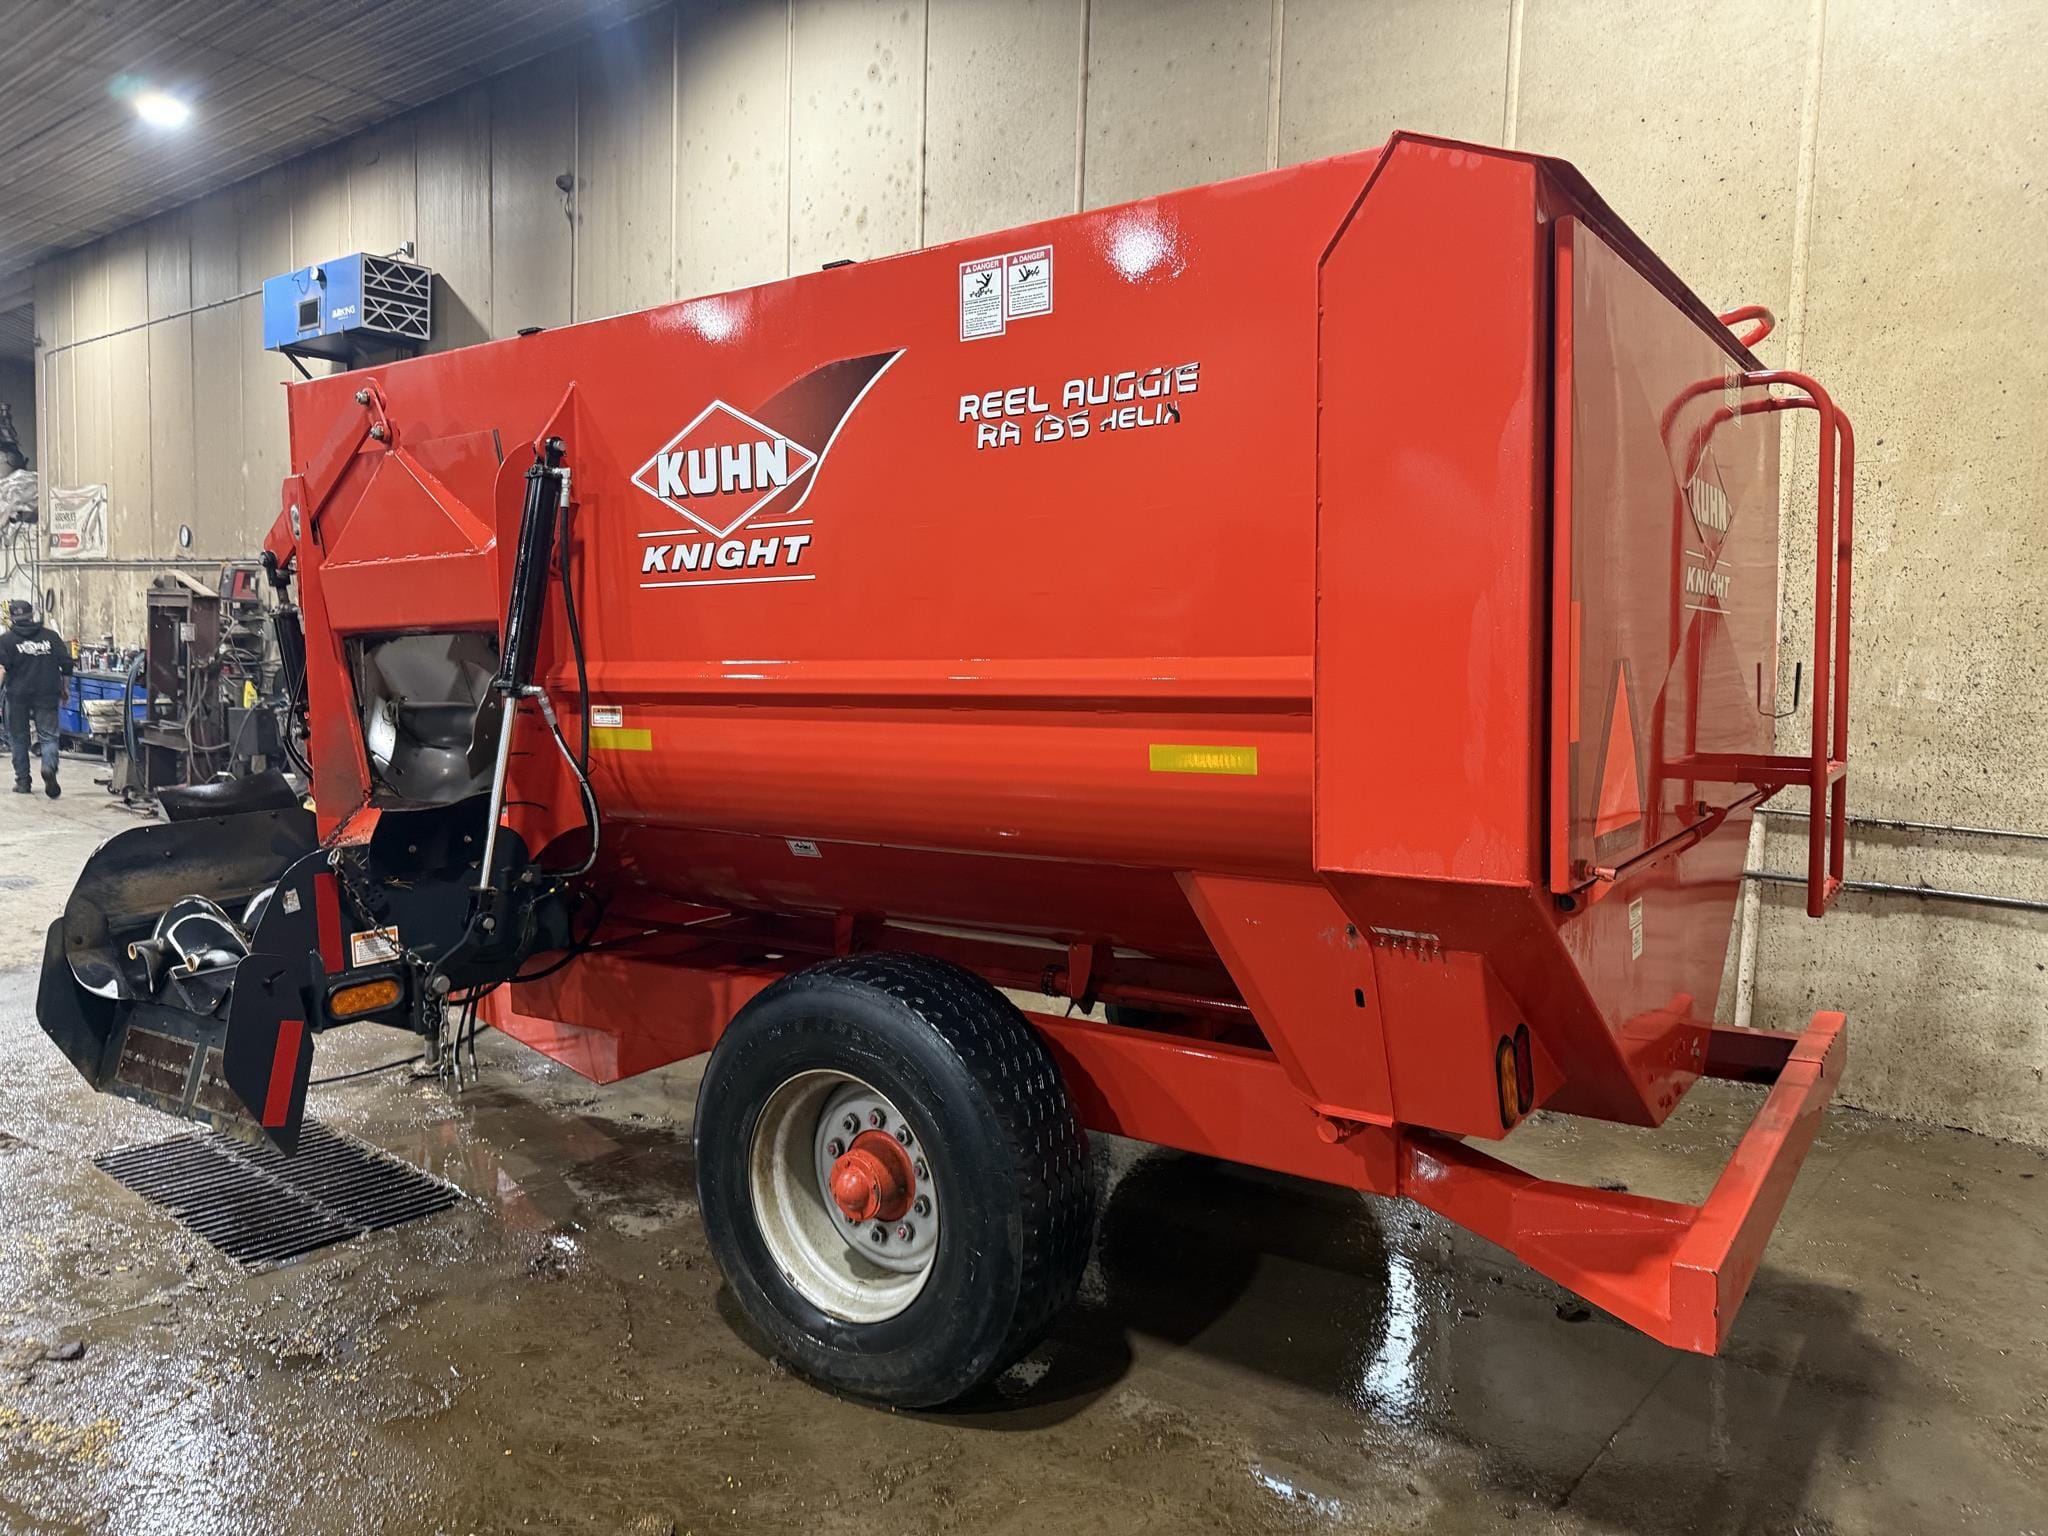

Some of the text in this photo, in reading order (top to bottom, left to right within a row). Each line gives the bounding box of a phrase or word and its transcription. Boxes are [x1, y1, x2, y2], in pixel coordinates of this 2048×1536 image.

[972, 260, 1000, 271] DANGER
[1019, 251, 1045, 262] DANGER
[959, 361, 1200, 422] REEL AUGGIE
[977, 420, 1021, 449] RA
[1034, 409, 1090, 442] 136
[657, 438, 788, 499] KUHN
[1692, 475, 1727, 532] KUHN
[641, 534, 811, 574] KNIGHT
[1685, 566, 1731, 599] KNIGHT
